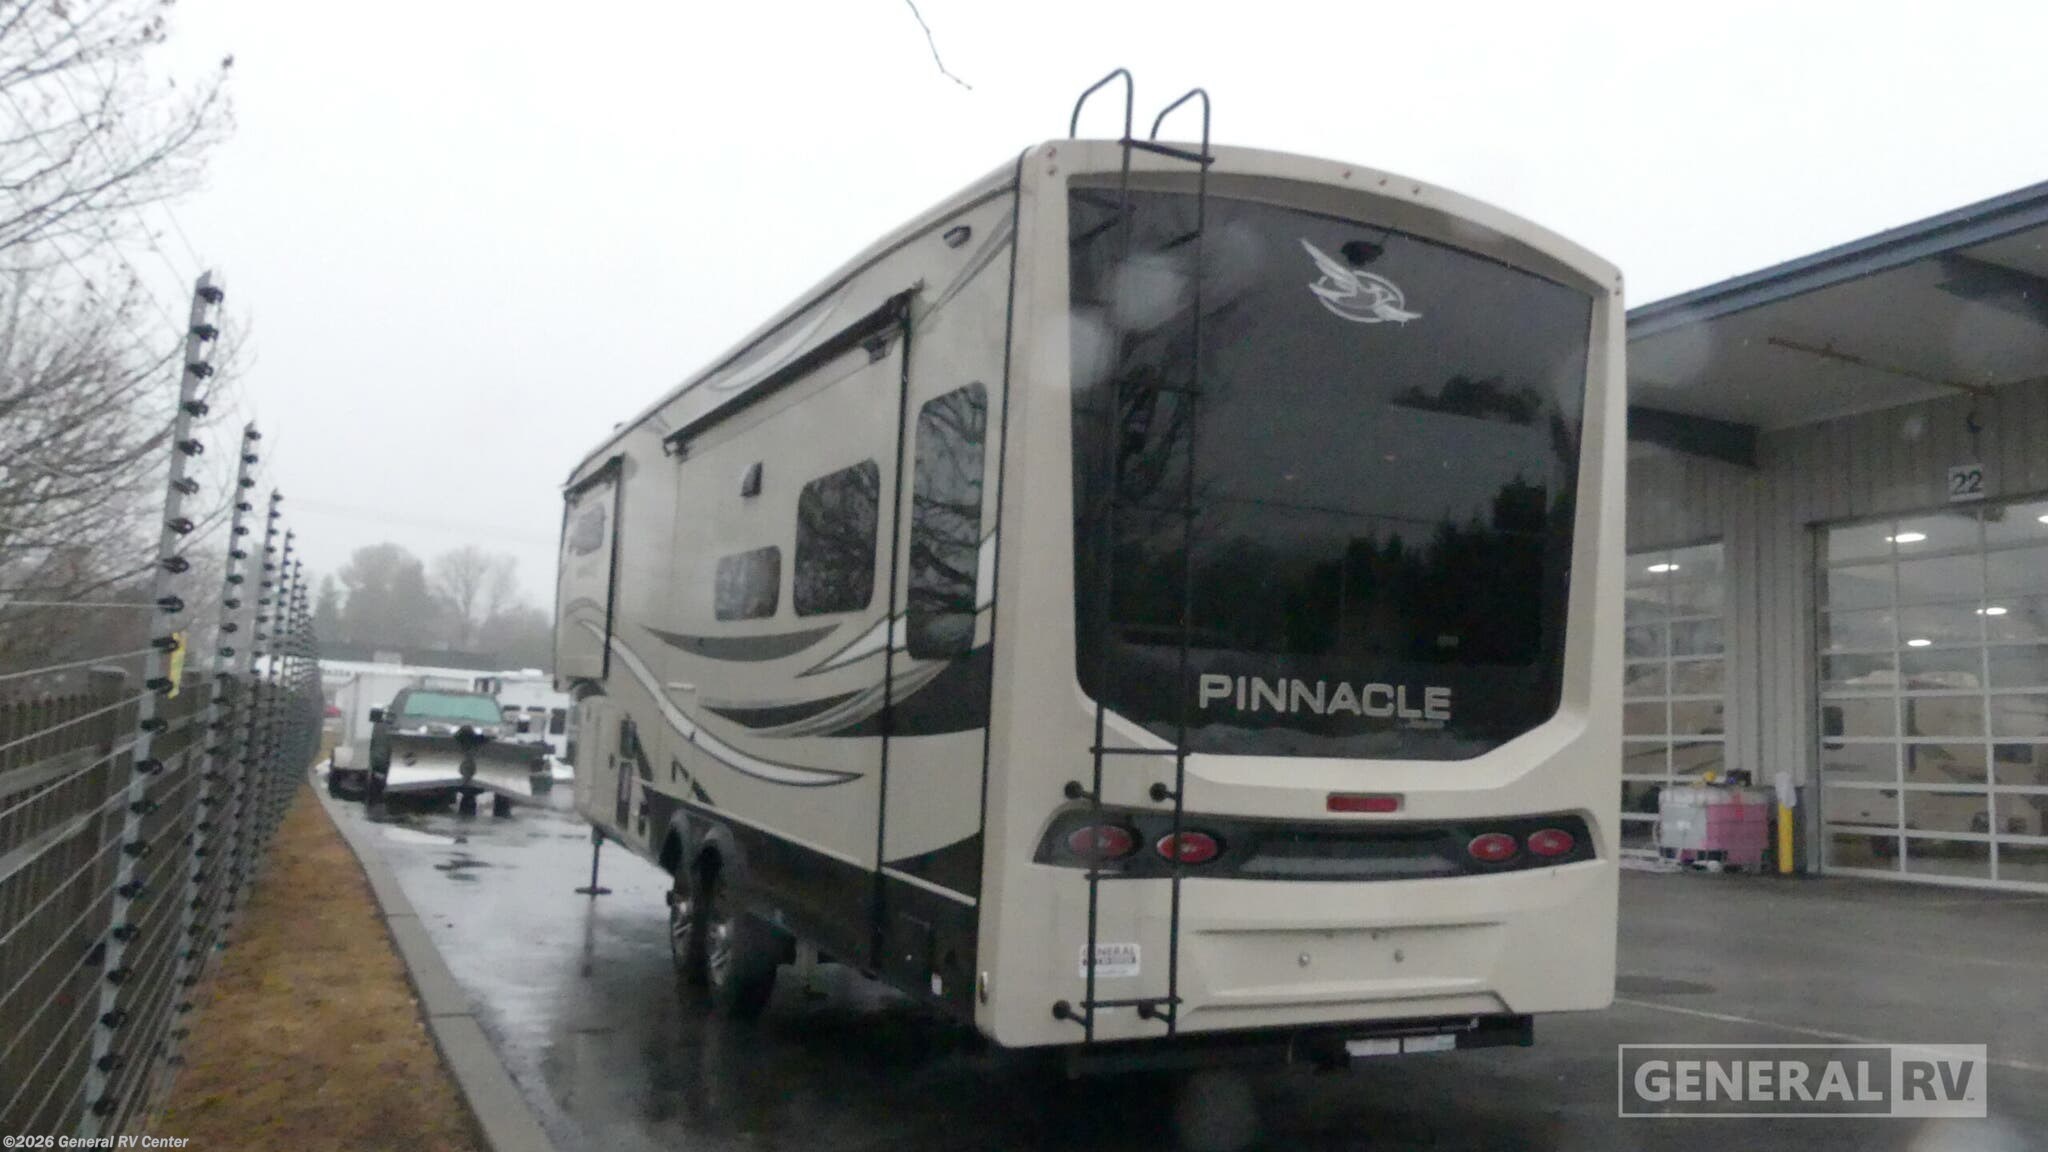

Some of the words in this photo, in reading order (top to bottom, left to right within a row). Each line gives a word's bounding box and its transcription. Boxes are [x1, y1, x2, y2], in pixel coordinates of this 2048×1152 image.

[1952, 470, 1982, 496] 22
[1199, 673, 1452, 720] PINNACLE
[1082, 946, 1136, 958] NERAL
